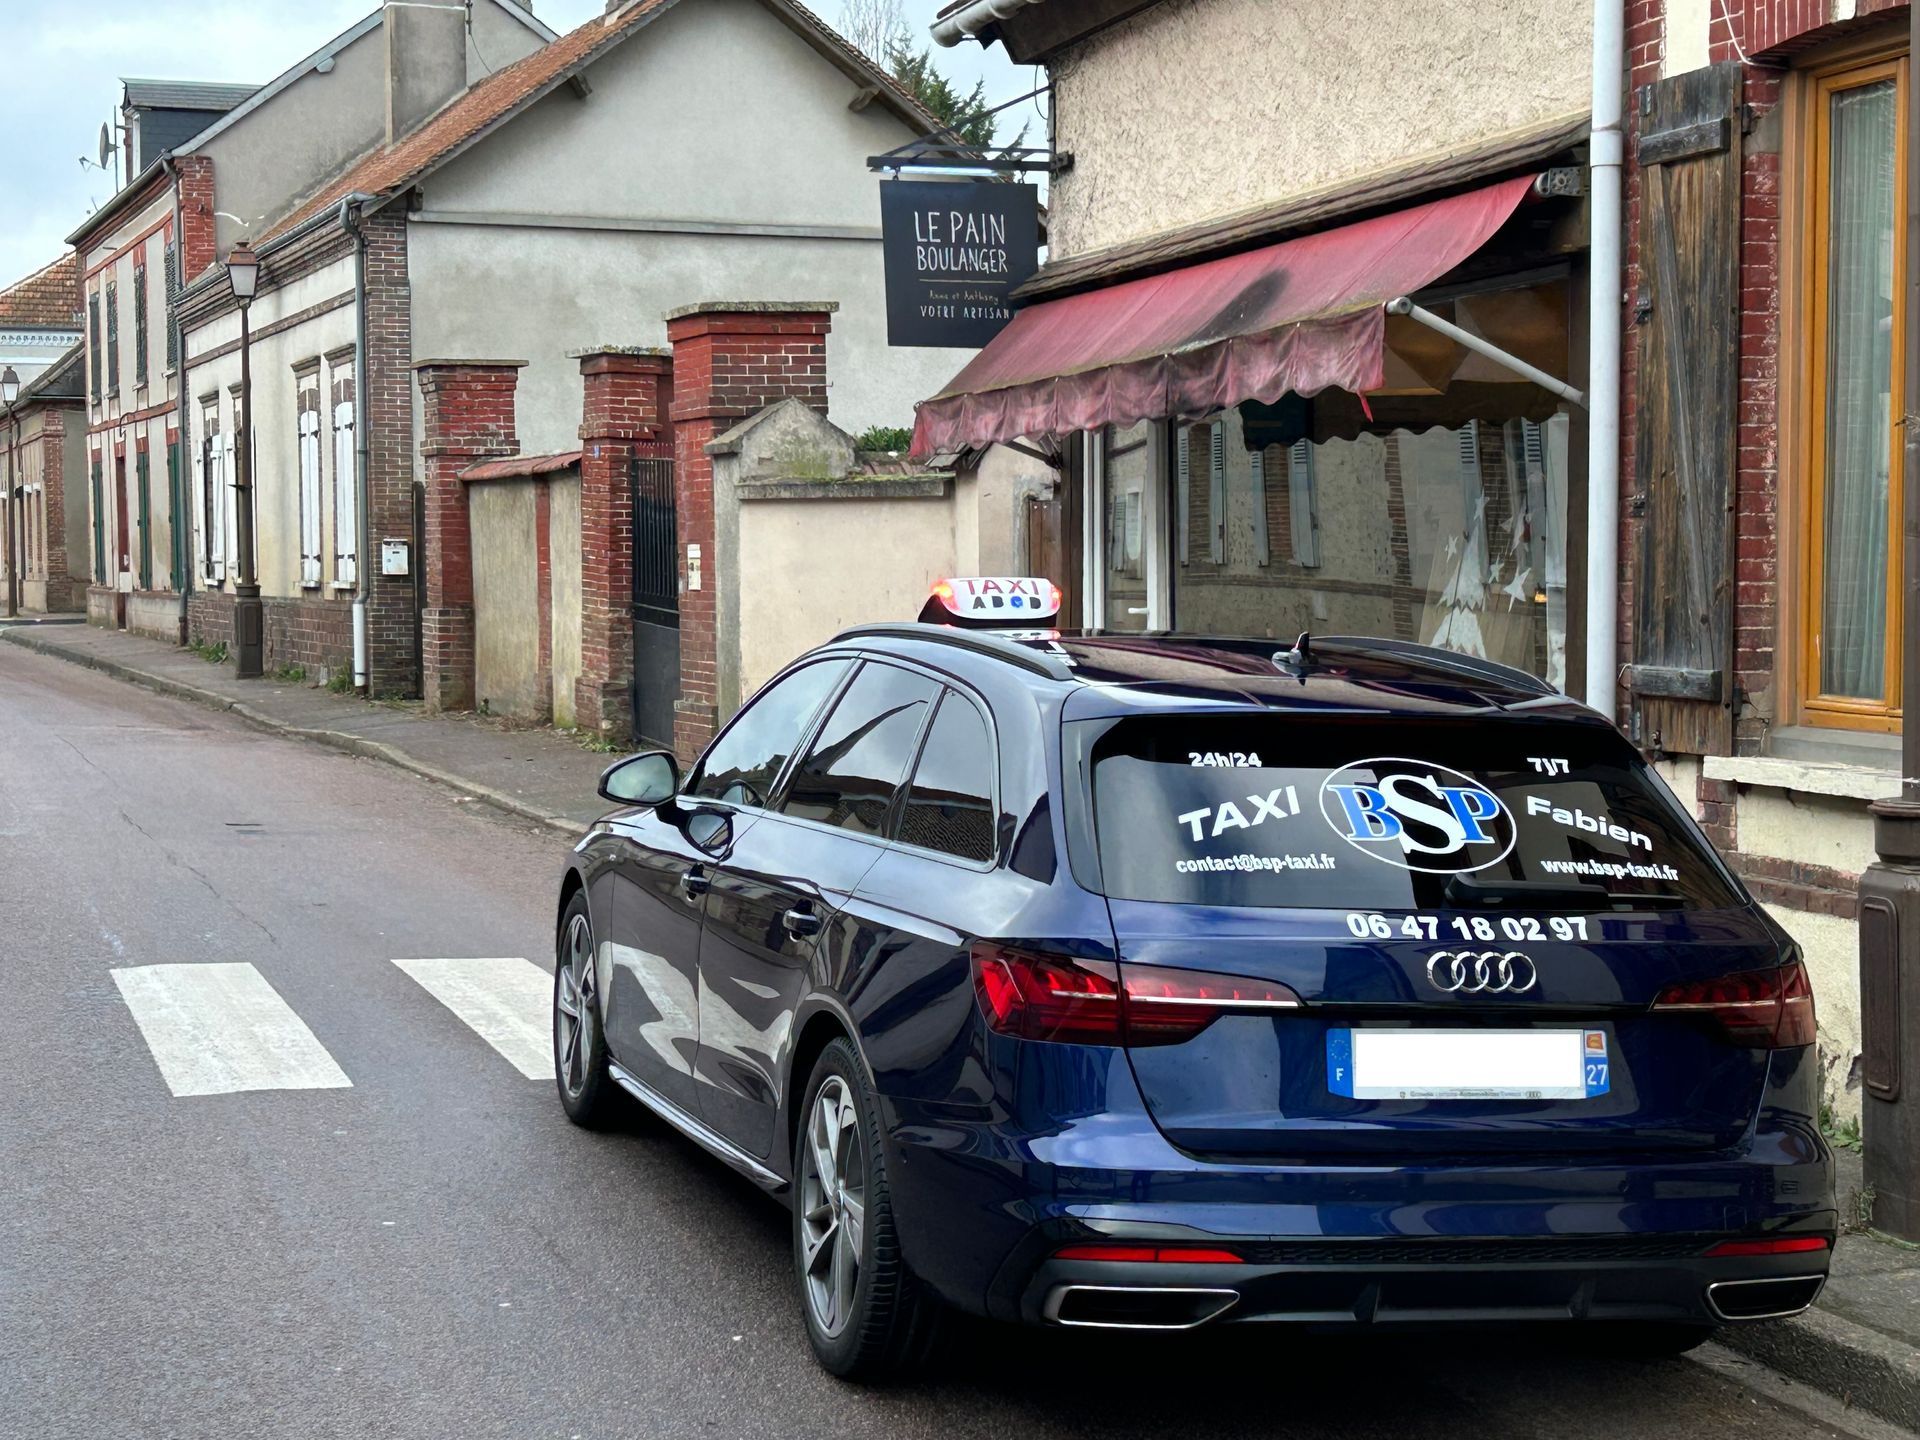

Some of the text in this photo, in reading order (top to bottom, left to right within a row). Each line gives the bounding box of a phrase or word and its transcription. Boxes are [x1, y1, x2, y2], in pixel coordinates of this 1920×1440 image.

[914, 211, 1005, 245] LE PAIN
[917, 246, 1008, 274] BOULANGER
[920, 305, 1010, 319] VOTRE ARTISAN
[959, 579, 1039, 596] TAXI
[1188, 752, 1263, 768] 24h/24
[1177, 785, 1301, 842] TAXI
[1327, 773, 1502, 857] BSP
[1526, 795, 1653, 852] Fabien
[1176, 853, 1336, 874] contact@bsp-taxi.fr
[1540, 859, 1679, 881] www.bsp-taxi.fr
[1346, 913, 1590, 941] 06 47 18 02 97
[1336, 1068, 1344, 1081] F
[1586, 1064, 1608, 1086] 27
